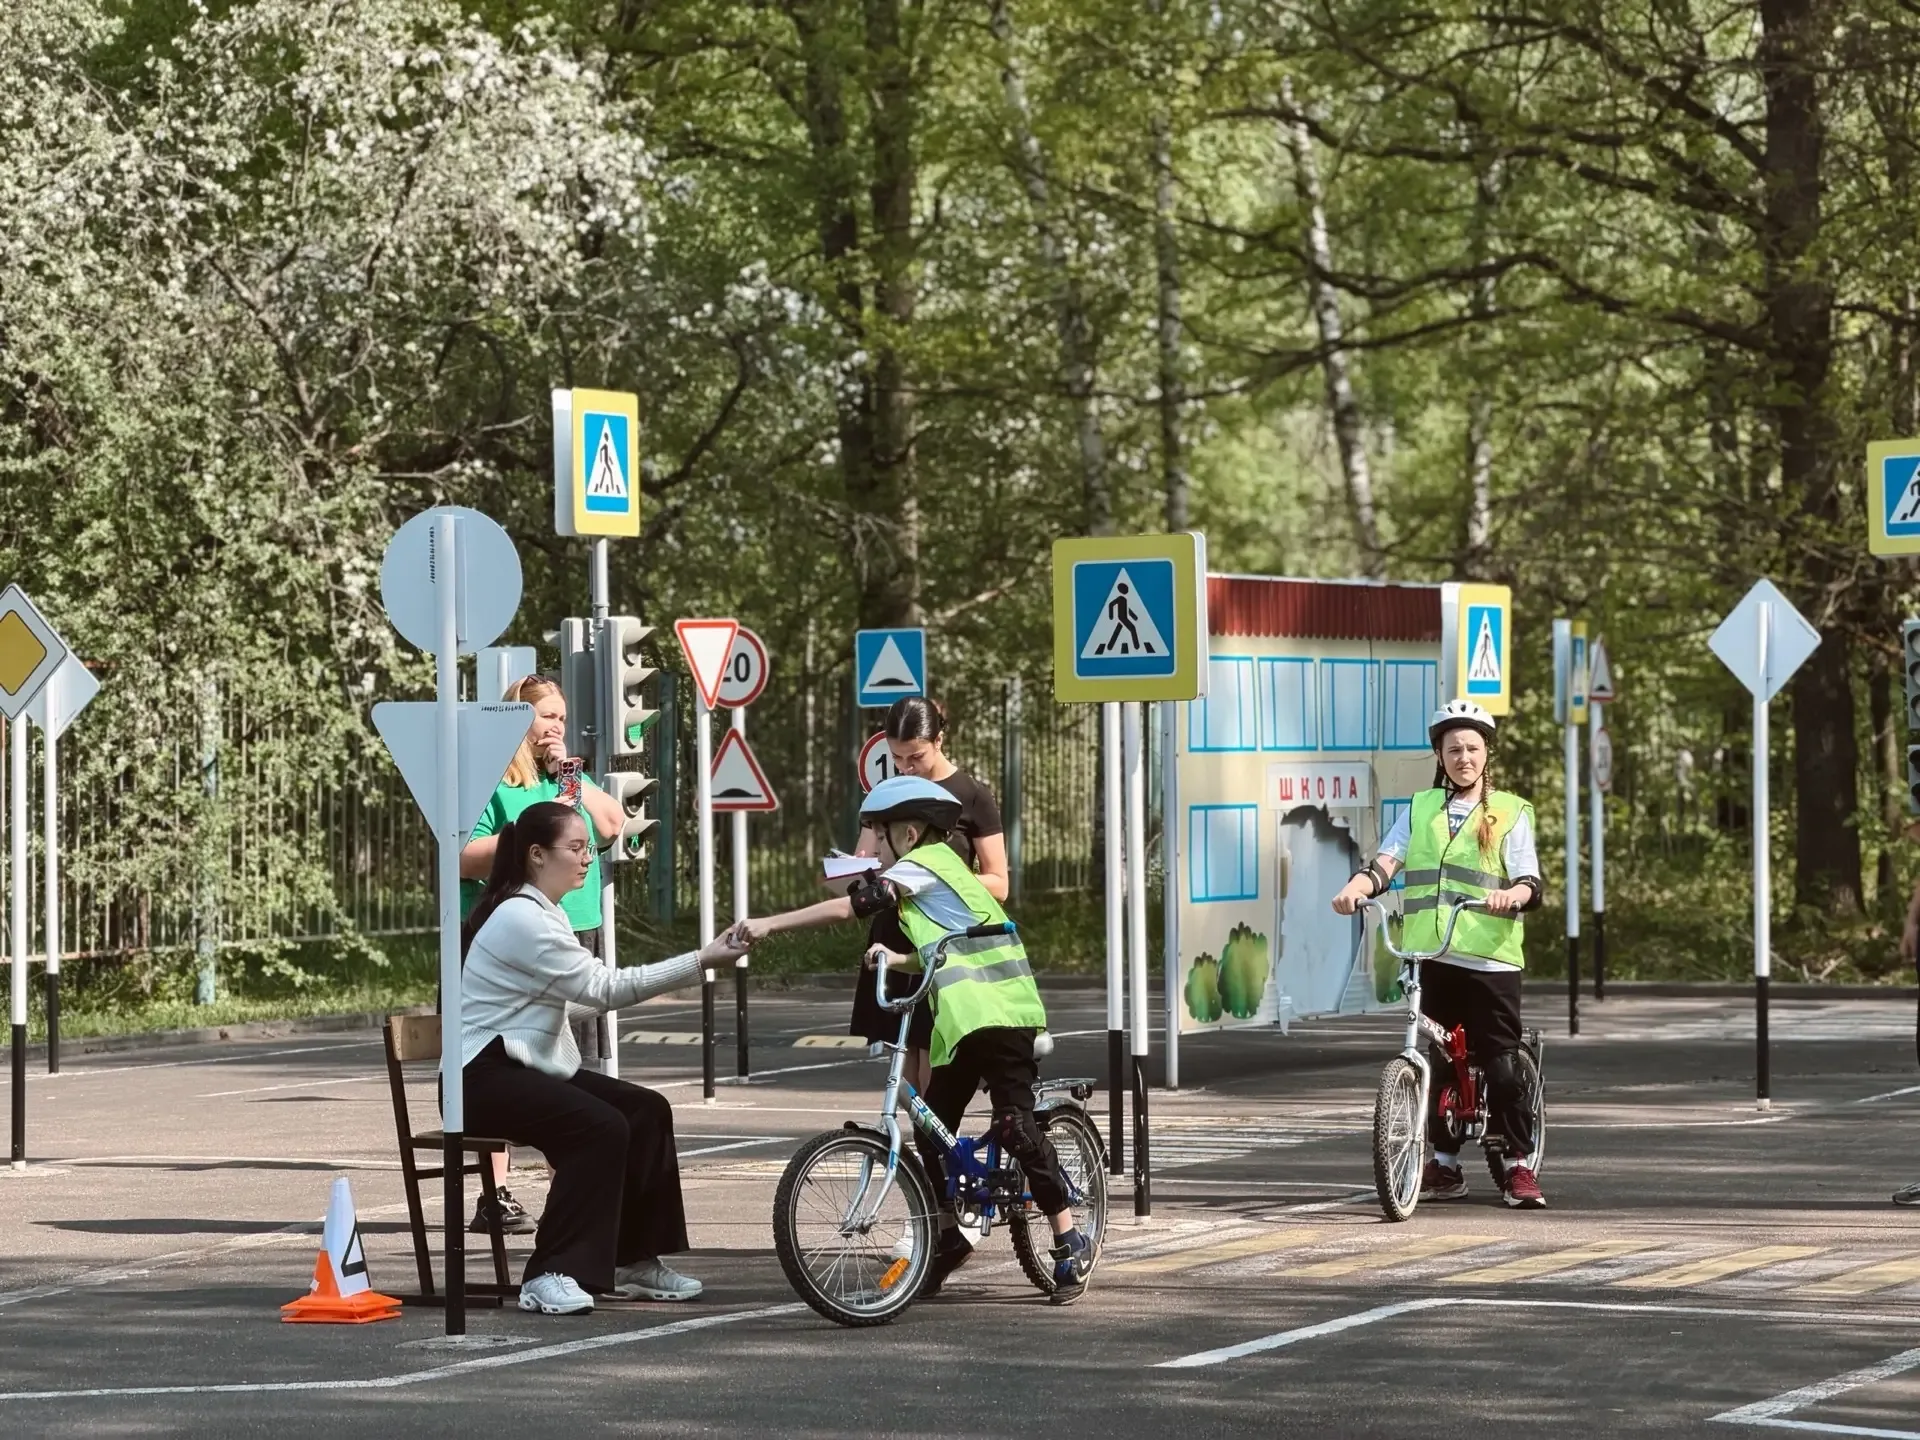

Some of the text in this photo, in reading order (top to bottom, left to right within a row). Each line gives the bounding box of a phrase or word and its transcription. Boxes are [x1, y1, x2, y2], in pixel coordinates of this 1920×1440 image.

[875, 753, 900, 780] 1
[1279, 776, 1358, 801] ШКОЛА
[911, 1095, 958, 1147] STELS
[341, 1213, 371, 1288] 4
